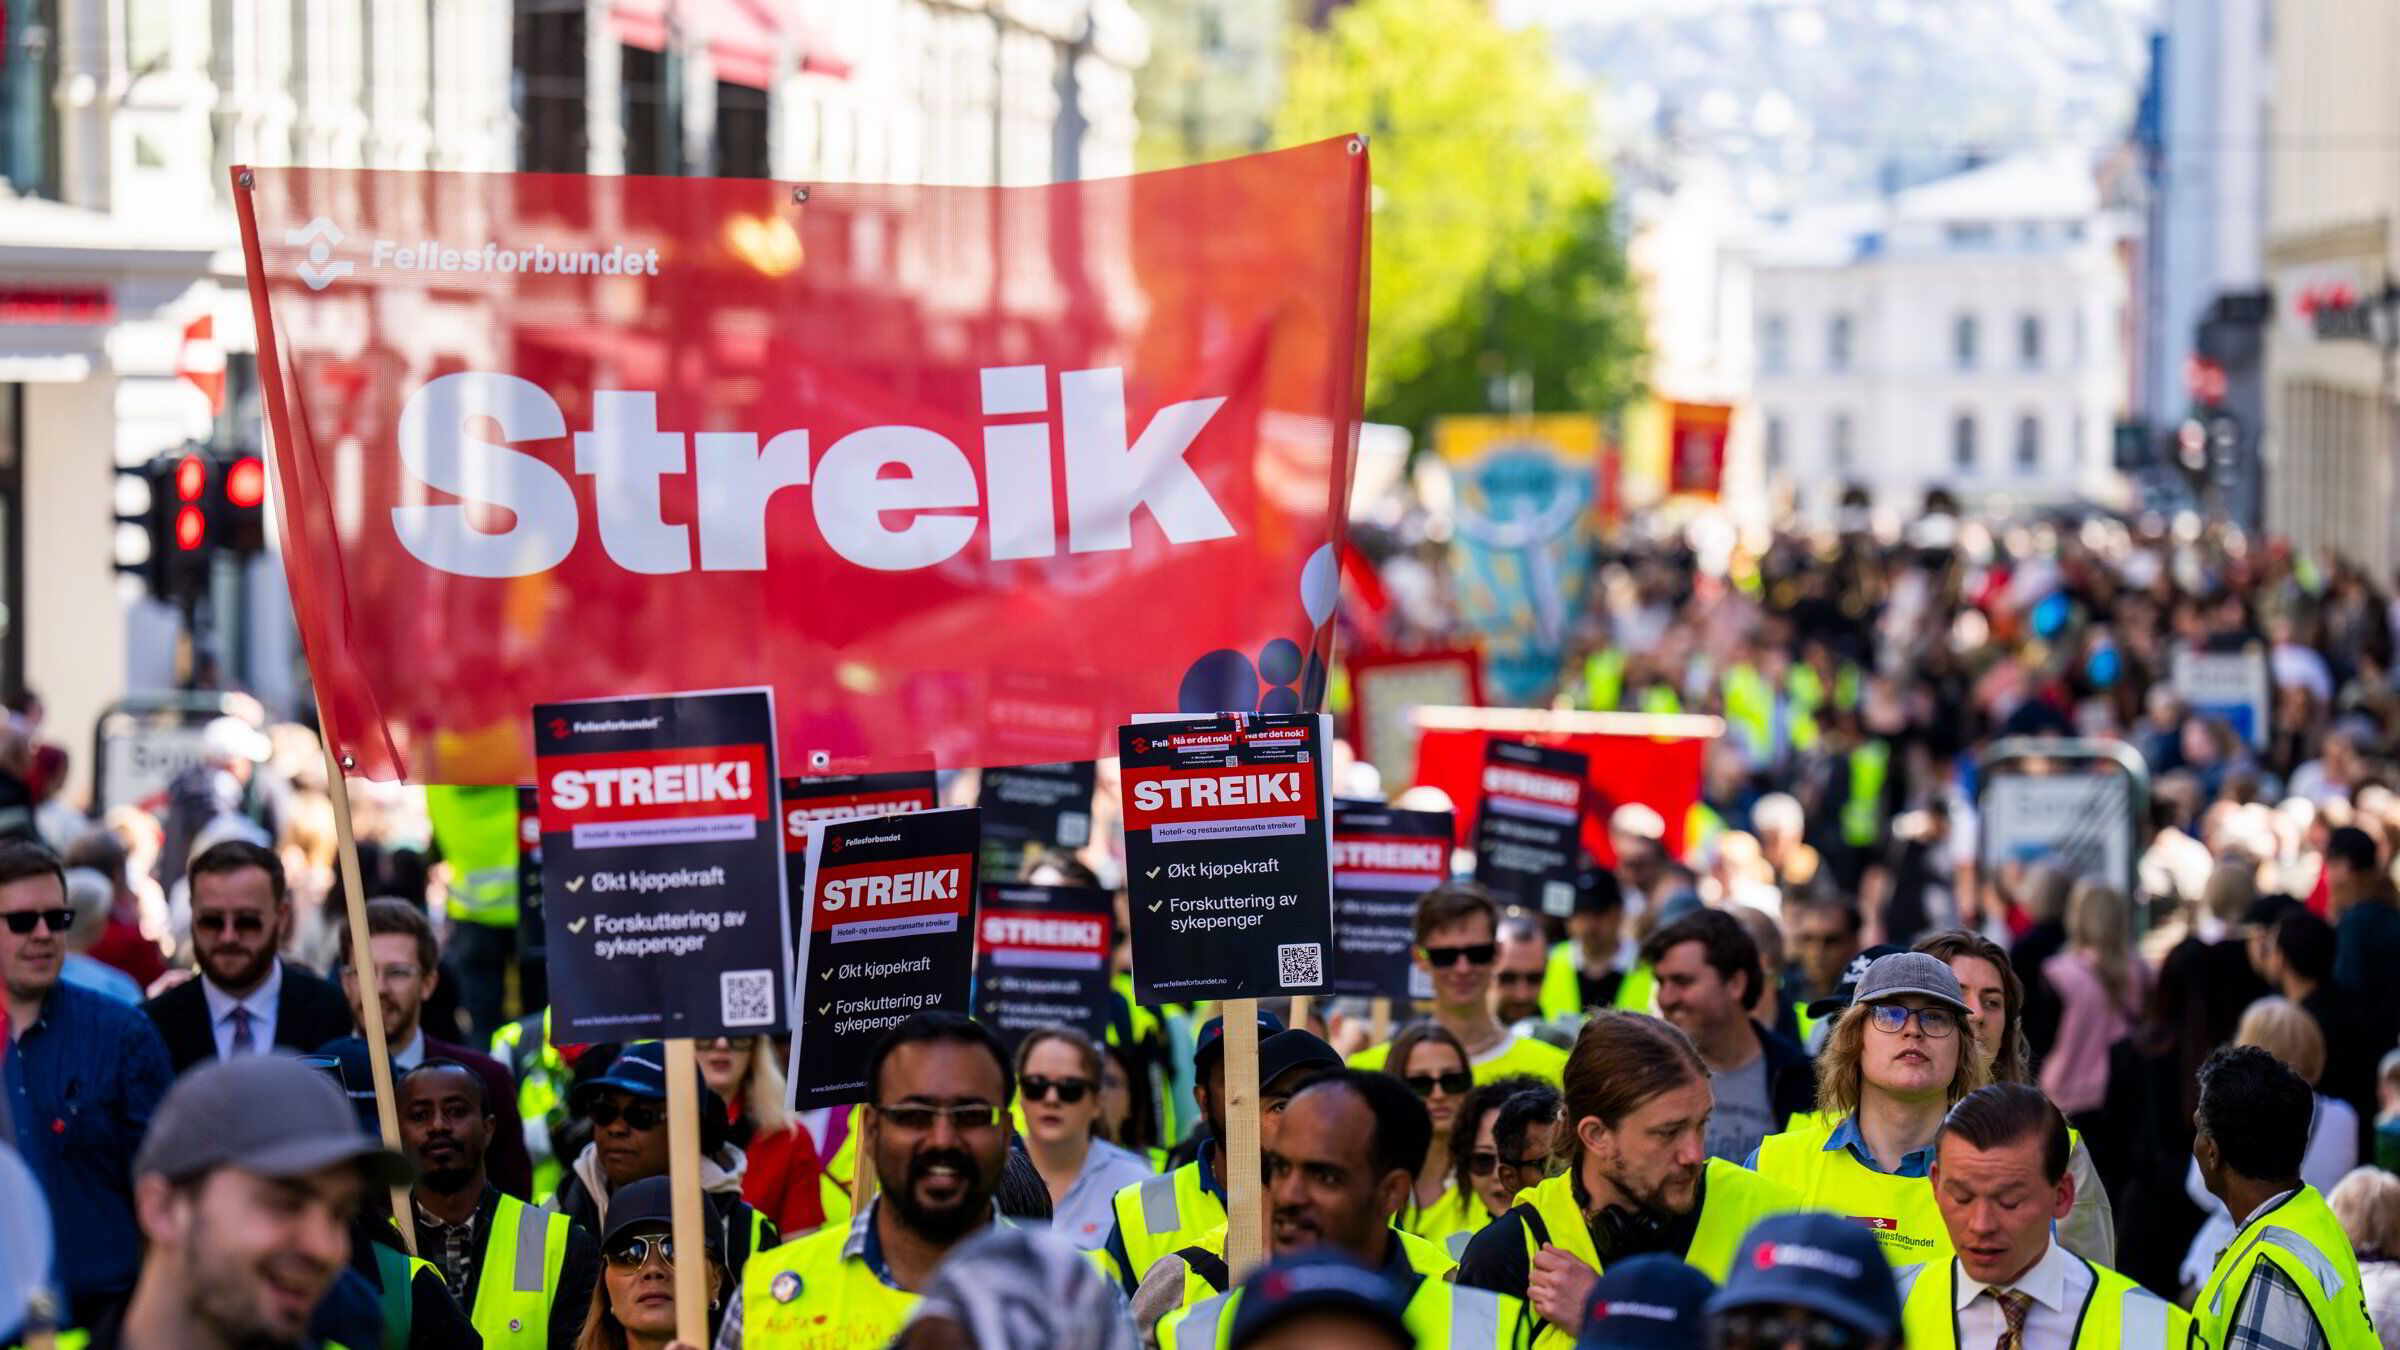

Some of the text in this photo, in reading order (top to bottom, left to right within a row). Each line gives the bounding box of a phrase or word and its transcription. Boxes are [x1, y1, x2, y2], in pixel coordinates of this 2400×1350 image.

[372, 240, 659, 276] Fellesforbundet
[391, 365, 1238, 578] Streik
[573, 717, 658, 733] Fellesforbundet
[1269, 730, 1284, 738] det
[1284, 729, 1304, 737] nok!
[1173, 736, 1186, 745] Nå
[1196, 735, 1212, 743] det
[1212, 733, 1232, 743] nok!
[551, 760, 752, 810] STREIK!
[1134, 772, 1301, 811] STREIK!
[1159, 821, 1297, 837] Hotell- og restaurantansatte streiker
[845, 833, 901, 847] Fellesforbundet
[591, 865, 725, 893] Økt kjøpekraft
[1167, 858, 1280, 879] Økt kjøpekraft
[822, 868, 960, 911] STREIK!
[1170, 894, 1298, 912] Forskuttering av
[593, 909, 747, 934] Forskuttering av
[837, 919, 950, 937] Hotell- og restaurantansatte streiker
[1171, 914, 1264, 933] sykepenger
[983, 917, 1102, 948] STREIK!
[594, 935, 706, 960] sykepenger
[838, 956, 931, 980] Økt kjøpekraft
[1152, 978, 1227, 989] www.fellesforbundet.no
[836, 993, 942, 1014] Forskuttering av
